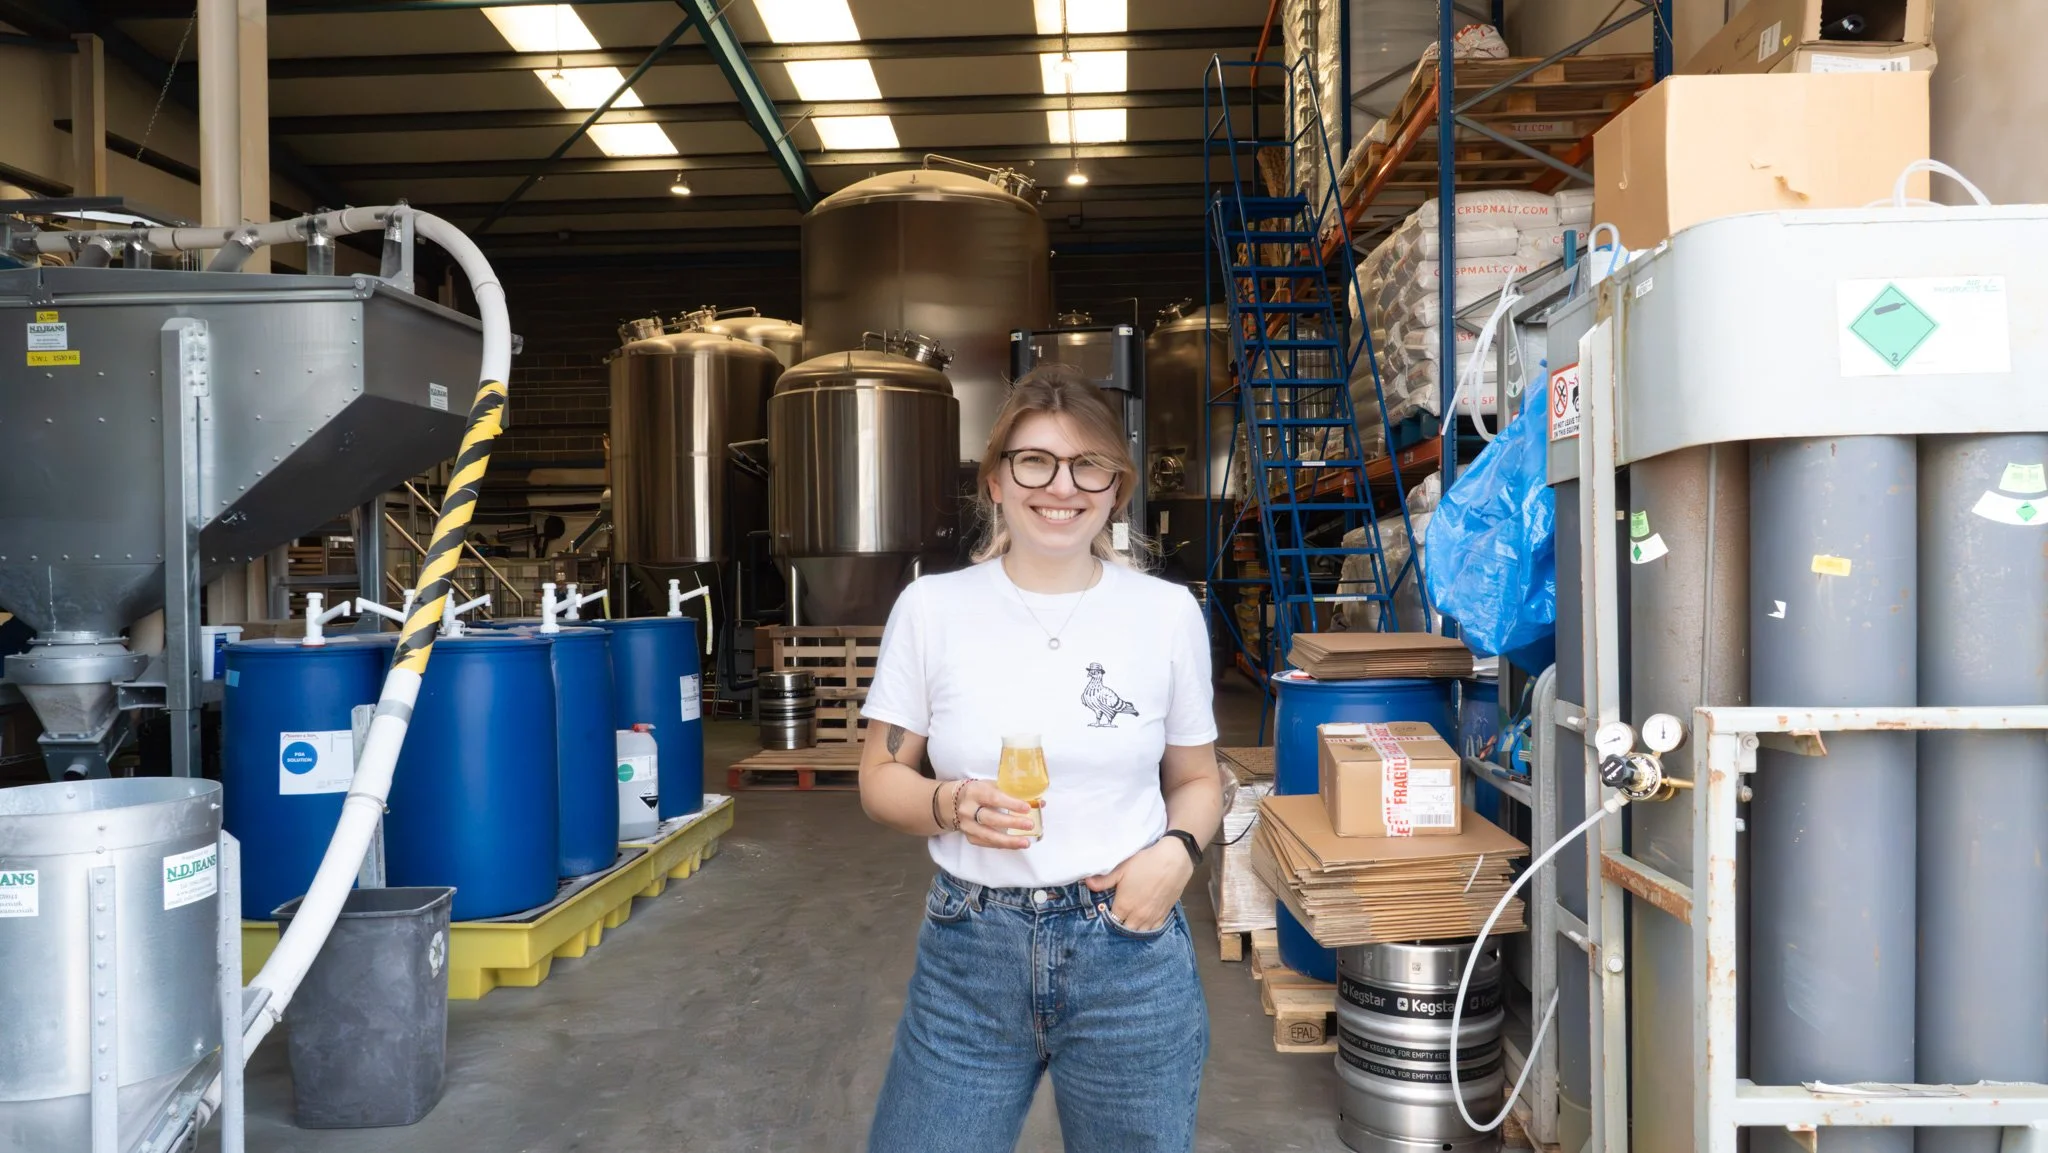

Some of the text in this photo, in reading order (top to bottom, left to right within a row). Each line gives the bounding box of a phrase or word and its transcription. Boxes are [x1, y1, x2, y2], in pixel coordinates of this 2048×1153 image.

[1457, 204, 1549, 216] CRISPMALT.COM
[1891, 352, 1899, 362] 2
[1349, 985, 1387, 1007] Kegstar
[1412, 999, 1456, 1016] Kegsta
[1291, 1027, 1315, 1039] EPAL
[1397, 1049, 1411, 1058] FOR
[1411, 1051, 1434, 1059] EMPTY
[1397, 1070, 1411, 1079] FOR
[1411, 1072, 1434, 1081] EMPTY
